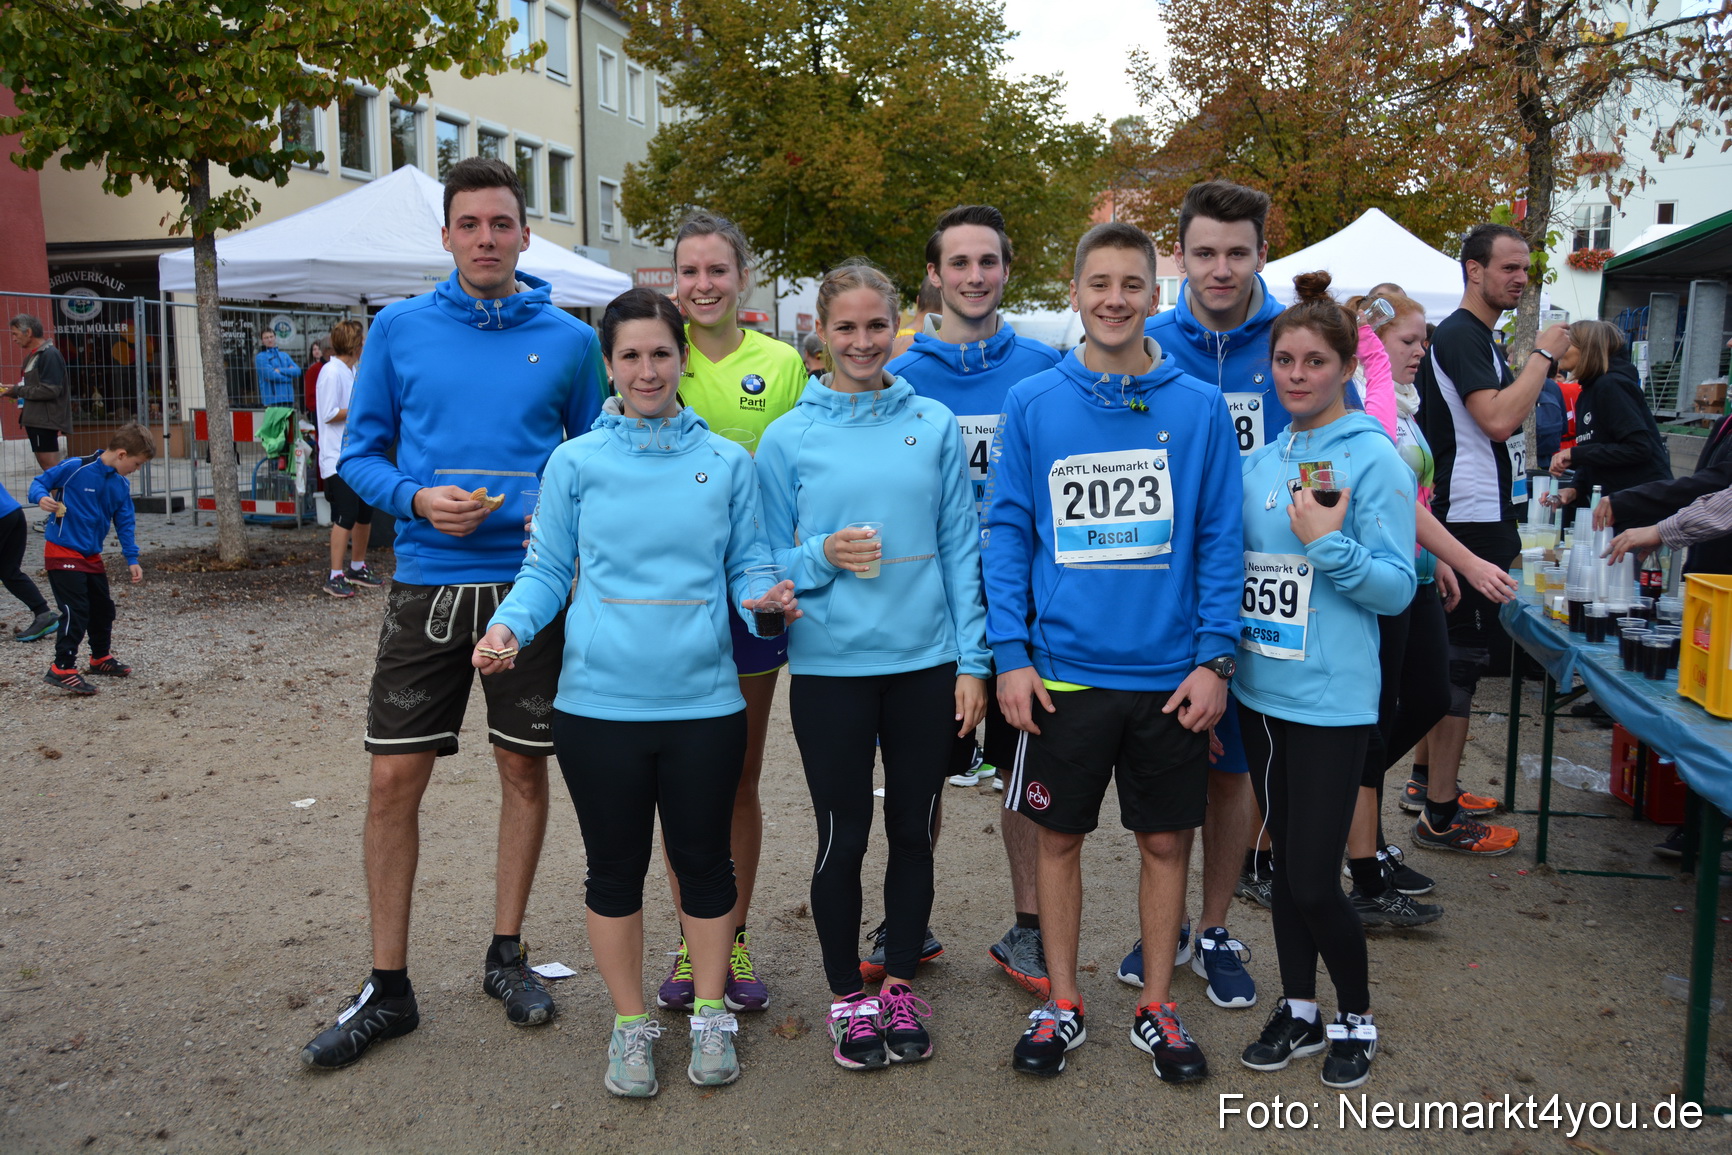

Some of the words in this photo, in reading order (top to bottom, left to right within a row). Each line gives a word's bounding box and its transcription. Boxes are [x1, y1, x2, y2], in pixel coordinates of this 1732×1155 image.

[638, 272, 673, 285] NKD
[87, 322, 129, 333] MÜLLER
[739, 405, 766, 413] Neumarkt
[740, 396, 766, 408] Partl
[975, 425, 998, 435] Neu
[992, 412, 1008, 464] BMW
[1234, 415, 1255, 451] 8
[969, 440, 989, 475] 4
[1051, 465, 1090, 477] PARTL
[1092, 460, 1149, 474] Neumarkt
[1063, 475, 1162, 520] 2023
[1087, 527, 1139, 545] Pascal
[1248, 561, 1294, 574] Neumarkt
[1241, 576, 1299, 619] 659
[1028, 791, 1048, 806] FCN
